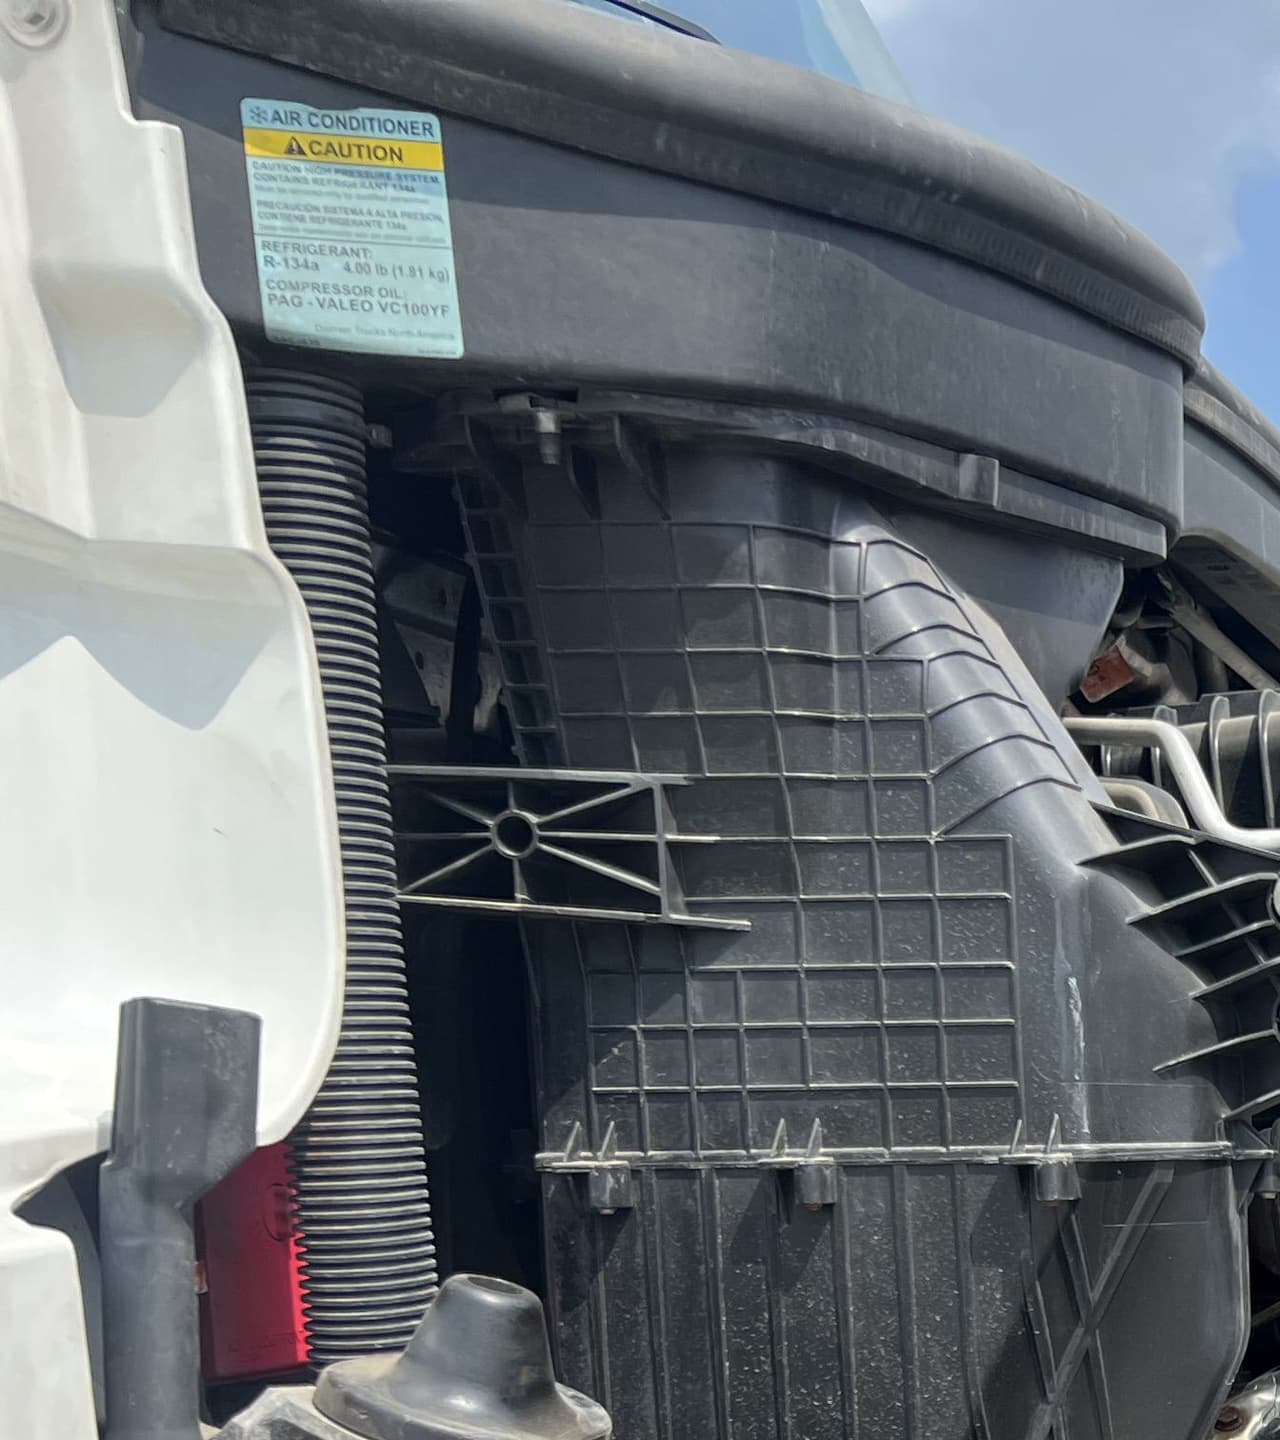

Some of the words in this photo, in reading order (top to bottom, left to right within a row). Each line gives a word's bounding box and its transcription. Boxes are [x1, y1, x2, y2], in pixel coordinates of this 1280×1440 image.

[271, 110, 301, 128] AIR
[307, 112, 434, 137] CONDITIONER
[308, 141, 403, 162] CAUTION
[261, 240, 373, 259] REFRIGERANT:
[263, 255, 320, 272] R-134a
[375, 263, 388, 277] lb
[428, 267, 450, 283] kg)
[265, 278, 374, 298] COMPRESSOR
[267, 292, 303, 308] PAG
[315, 297, 373, 313] VALEO
[378, 301, 449, 318] VC100YF
